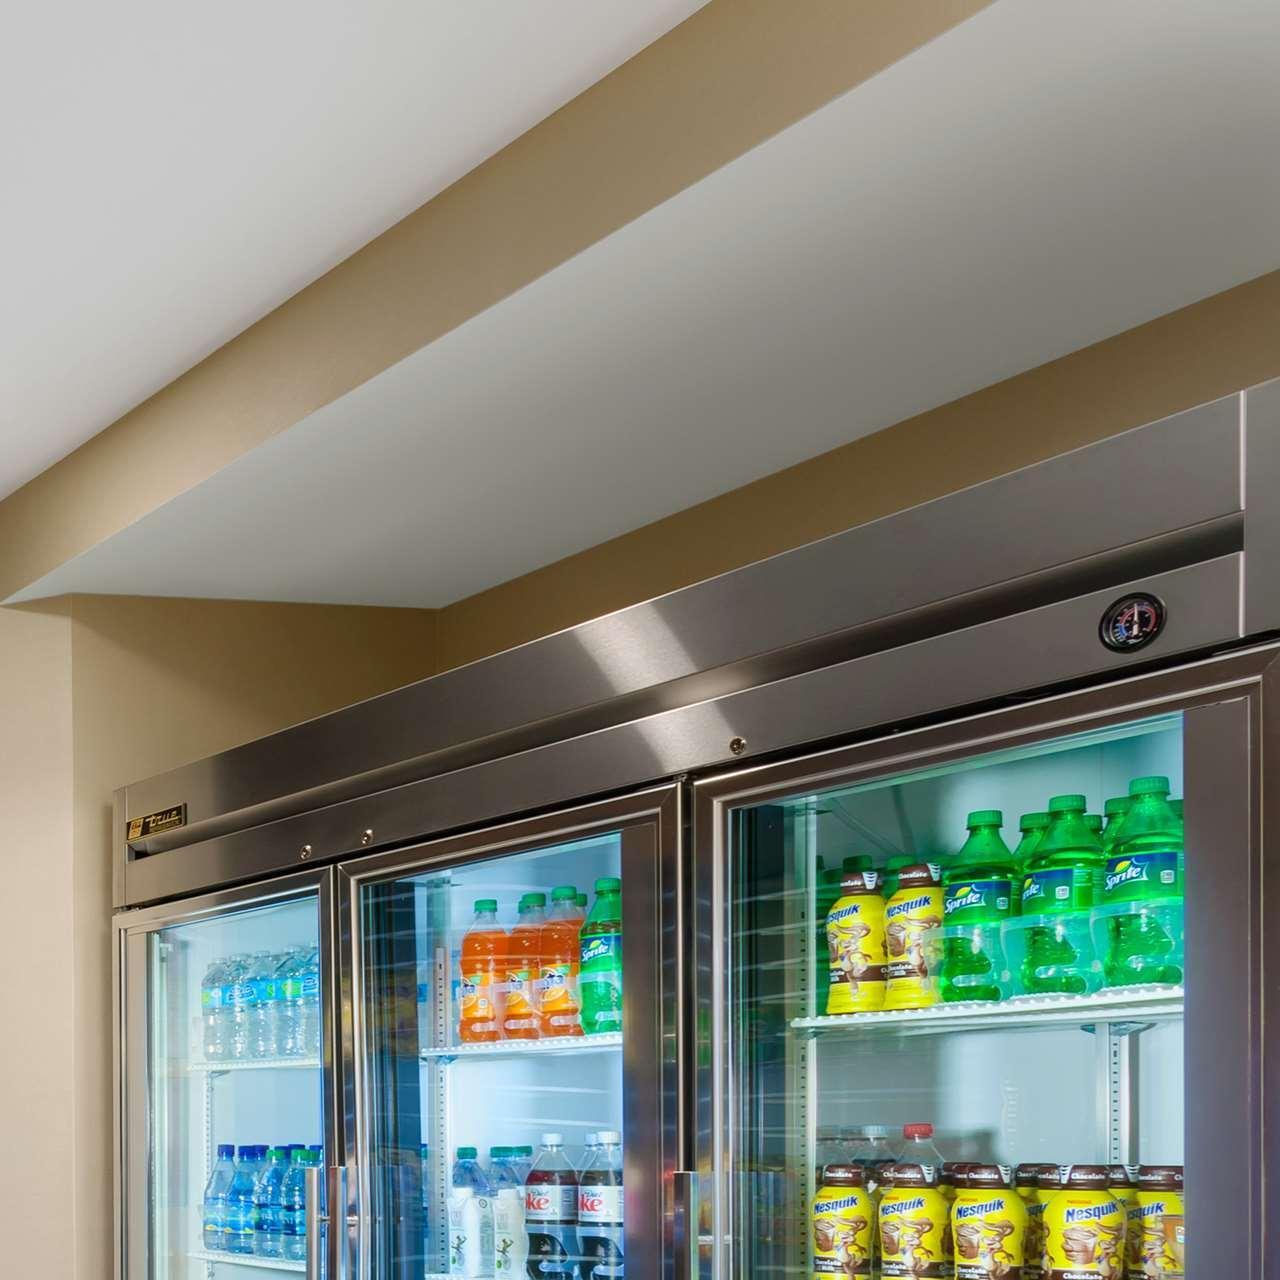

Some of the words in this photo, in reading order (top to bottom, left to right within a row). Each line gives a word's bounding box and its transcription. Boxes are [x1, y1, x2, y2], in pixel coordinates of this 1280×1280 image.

[1104, 864, 1143, 890] Sprite
[944, 888, 985, 913] Sprite
[581, 941, 610, 962] Sprite
[881, 1197, 926, 1217] Nesquik
[955, 1199, 1006, 1219] Nesquik
[1065, 1200, 1119, 1223] Nesquik
